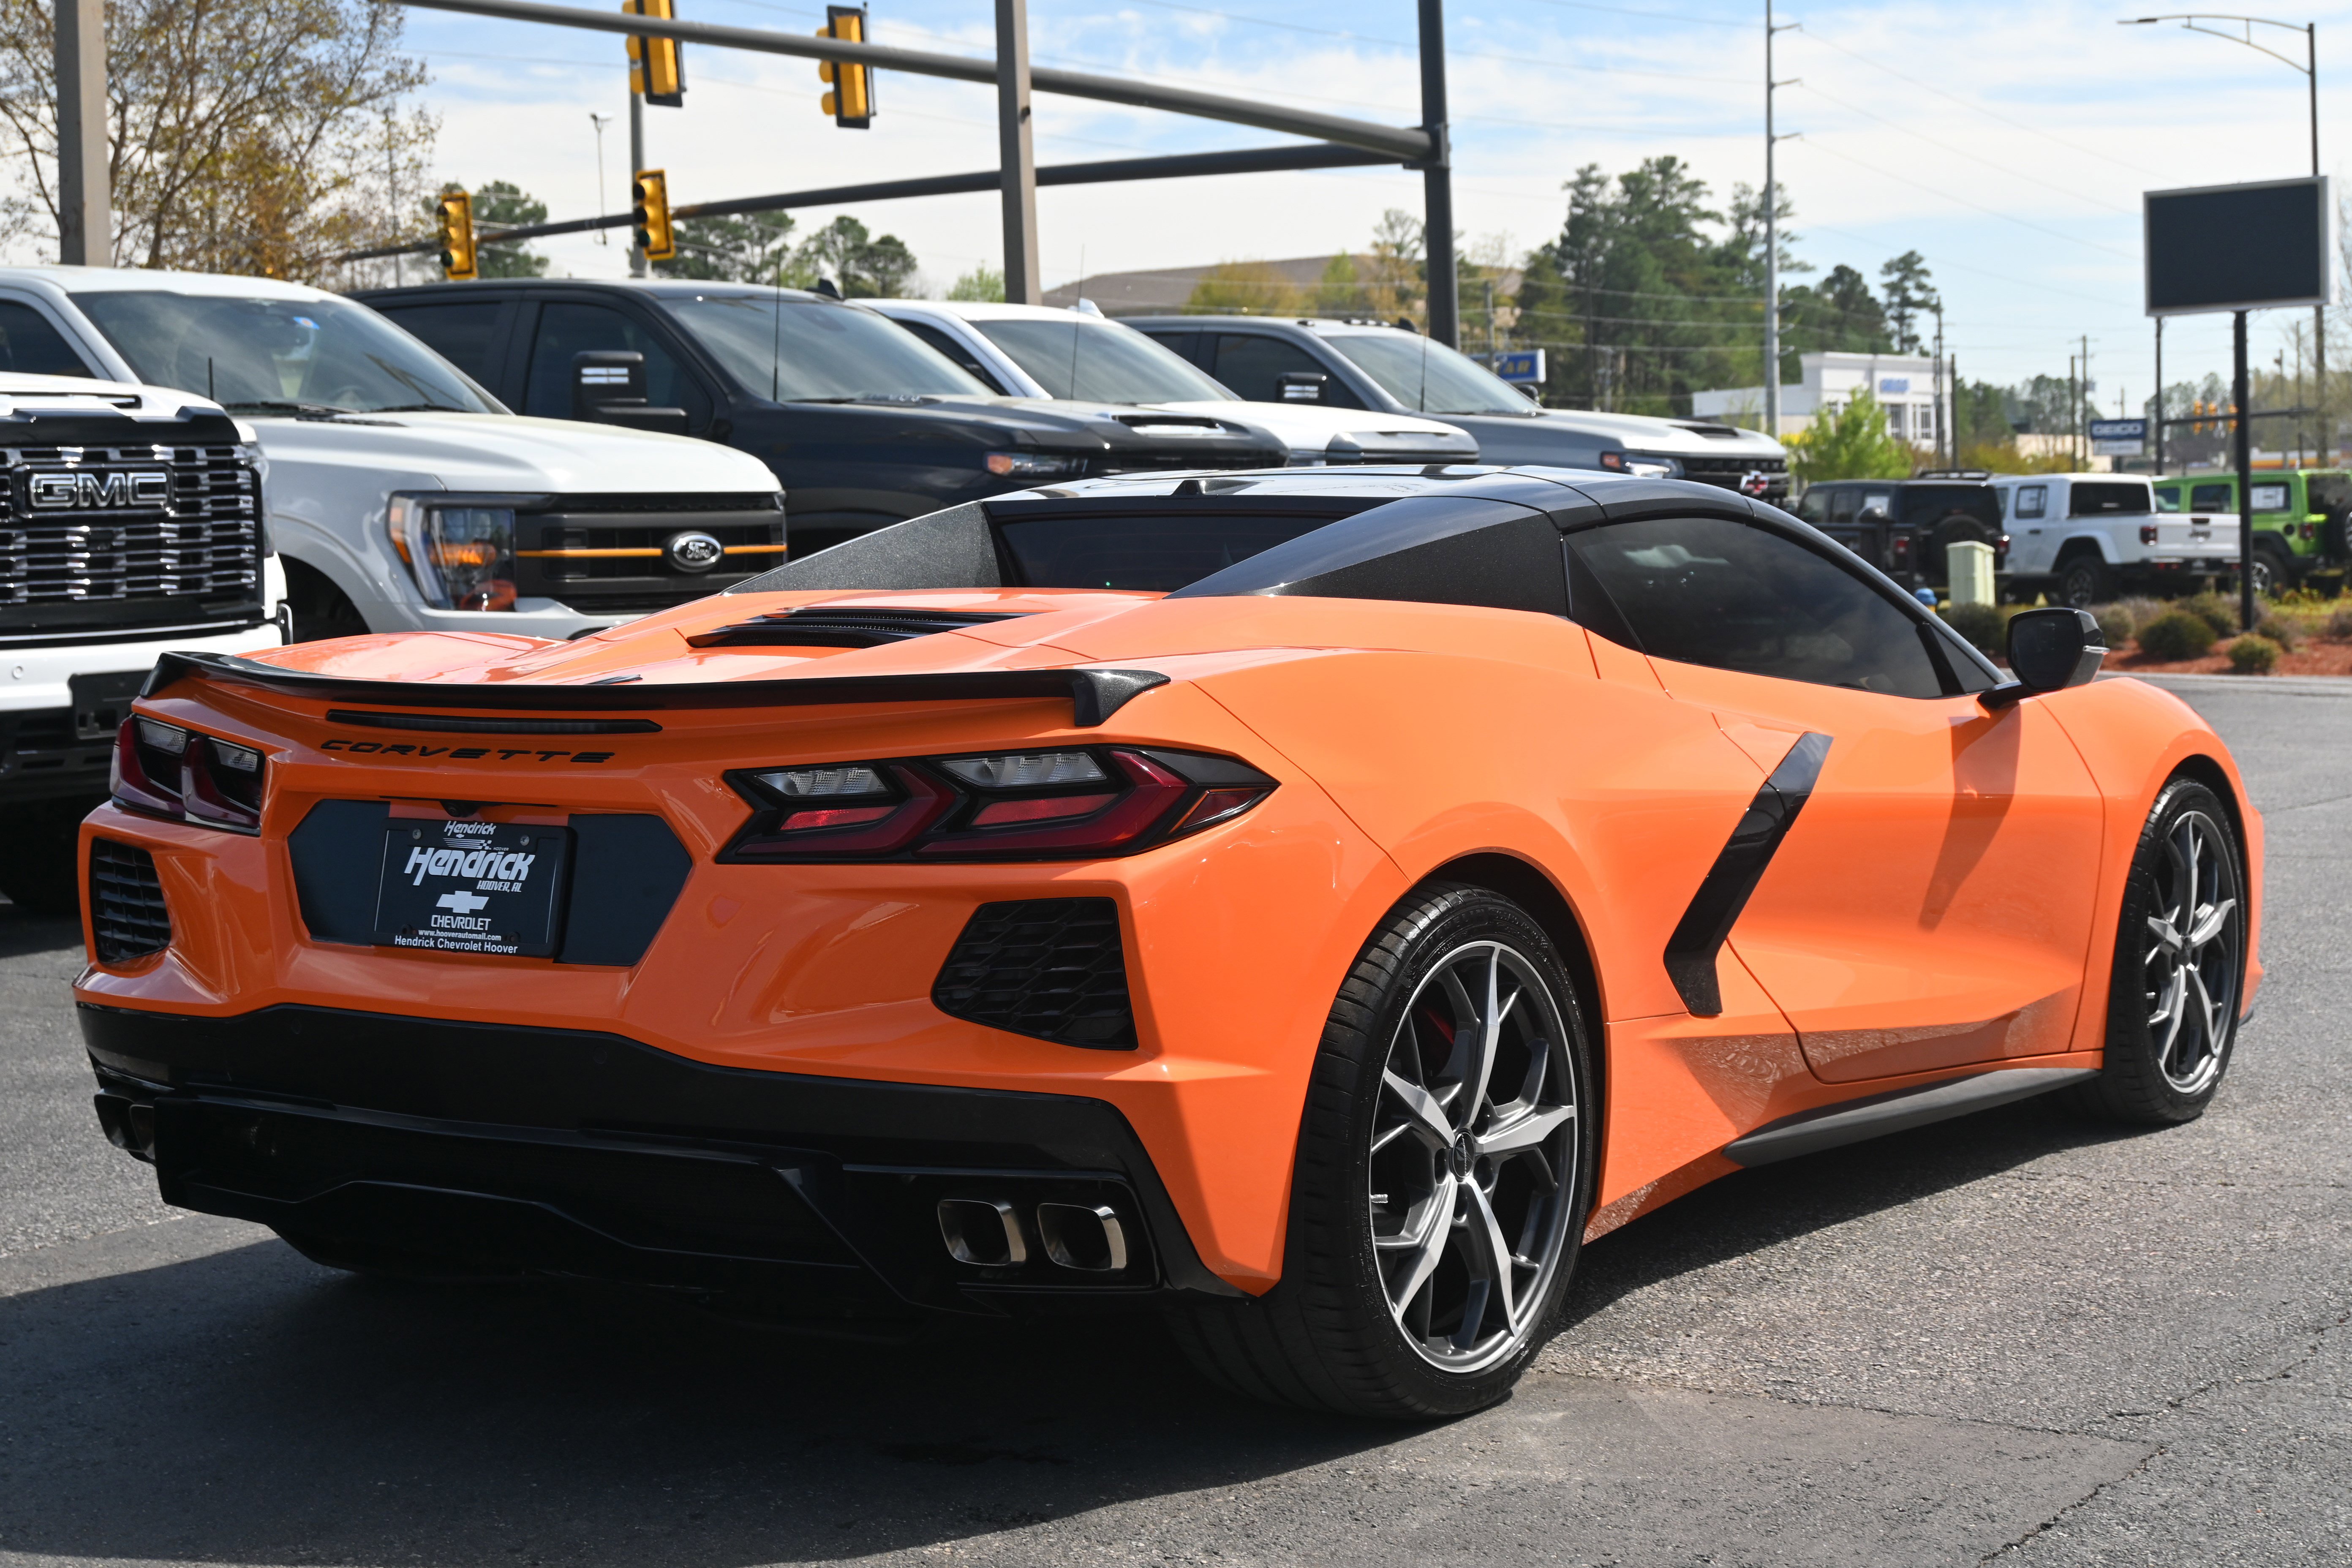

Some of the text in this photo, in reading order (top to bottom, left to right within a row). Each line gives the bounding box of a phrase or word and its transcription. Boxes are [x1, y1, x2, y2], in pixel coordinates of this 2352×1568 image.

[2092, 423, 2142, 436] GEICO
[30, 472, 167, 508] GMC
[687, 542, 712, 558] Ford
[320, 739, 615, 763] CORVETTE
[444, 820, 497, 836] Hendrick
[404, 846, 536, 886] Hendrick
[476, 880, 522, 893] HOOVER, AL
[431, 915, 491, 931] CHEVROLET
[418, 929, 502, 941] www.hooverautomall.com
[395, 935, 518, 954] Hendrick Chevrolet Hoover
